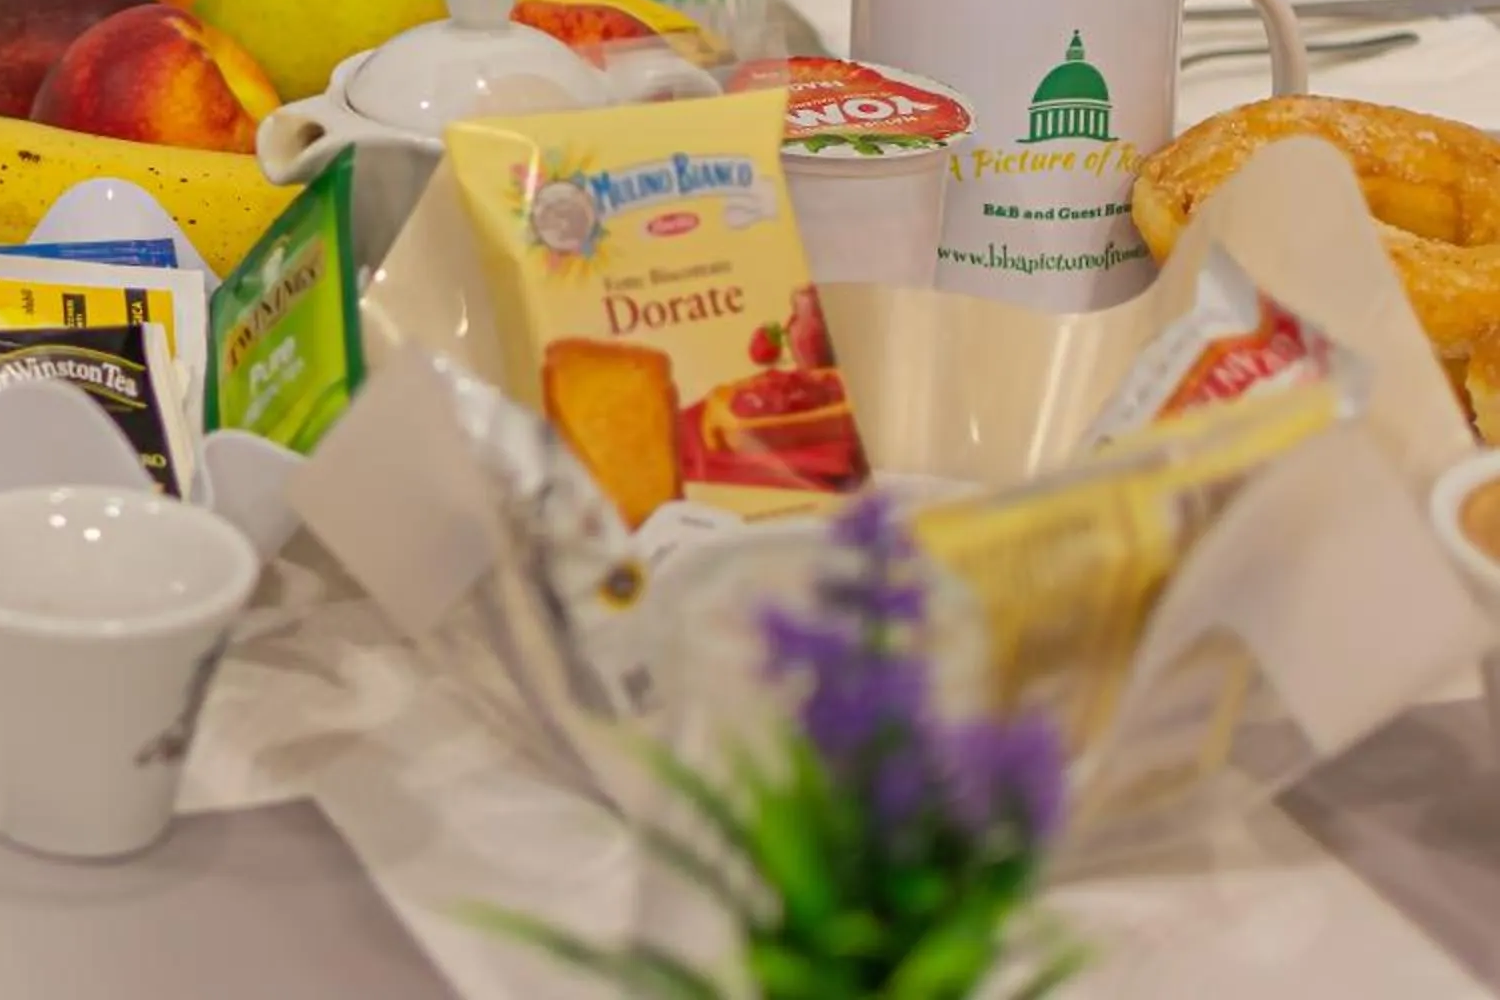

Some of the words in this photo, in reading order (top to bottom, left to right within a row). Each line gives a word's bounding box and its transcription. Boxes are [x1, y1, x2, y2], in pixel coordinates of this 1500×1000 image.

[784, 95, 938, 128] YOM
[972, 148, 1077, 179] Picture
[1083, 142, 1113, 177] of
[983, 203, 1020, 219] B&B
[1023, 206, 1054, 220] and
[1058, 206, 1102, 220] Guest
[1105, 202, 1133, 217] Hou
[602, 286, 745, 336] Dorate
